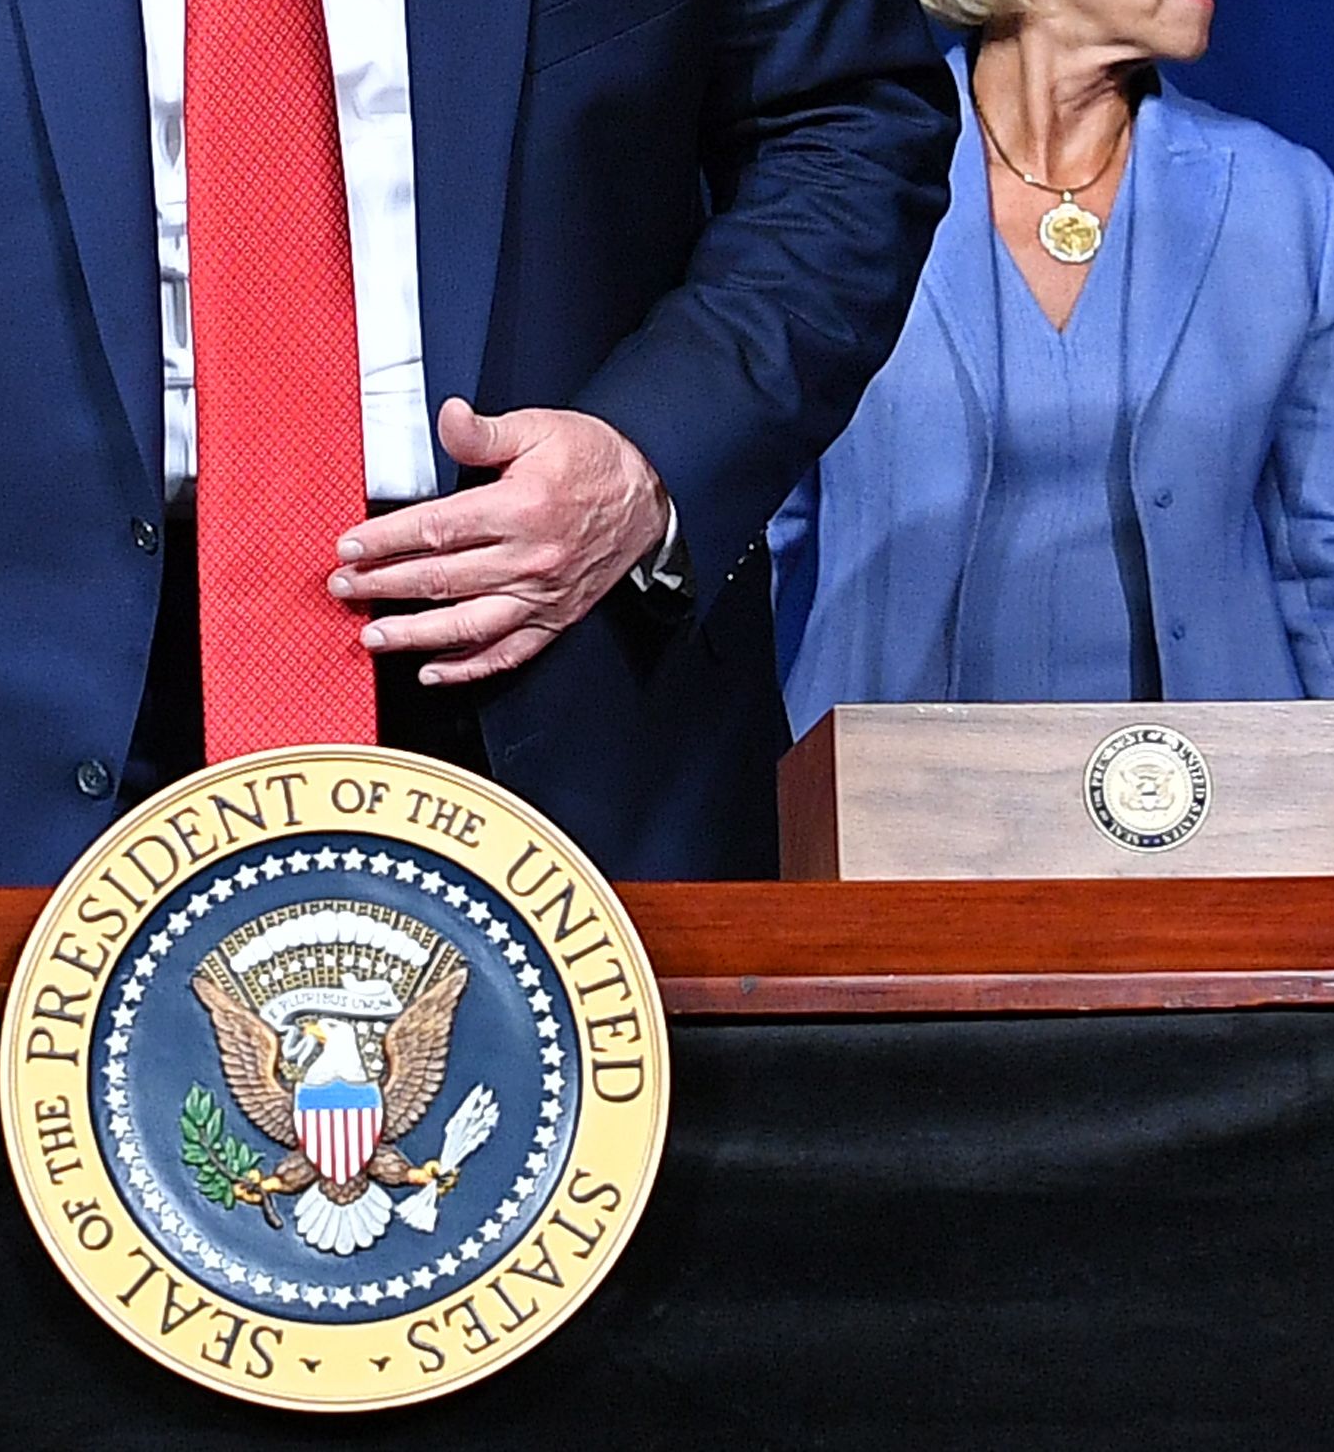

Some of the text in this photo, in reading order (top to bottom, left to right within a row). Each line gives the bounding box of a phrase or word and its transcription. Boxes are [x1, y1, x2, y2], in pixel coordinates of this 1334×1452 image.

[26, 772, 645, 1379] SEAL OF THE PRESIDENT OF THE UNITED STATES
